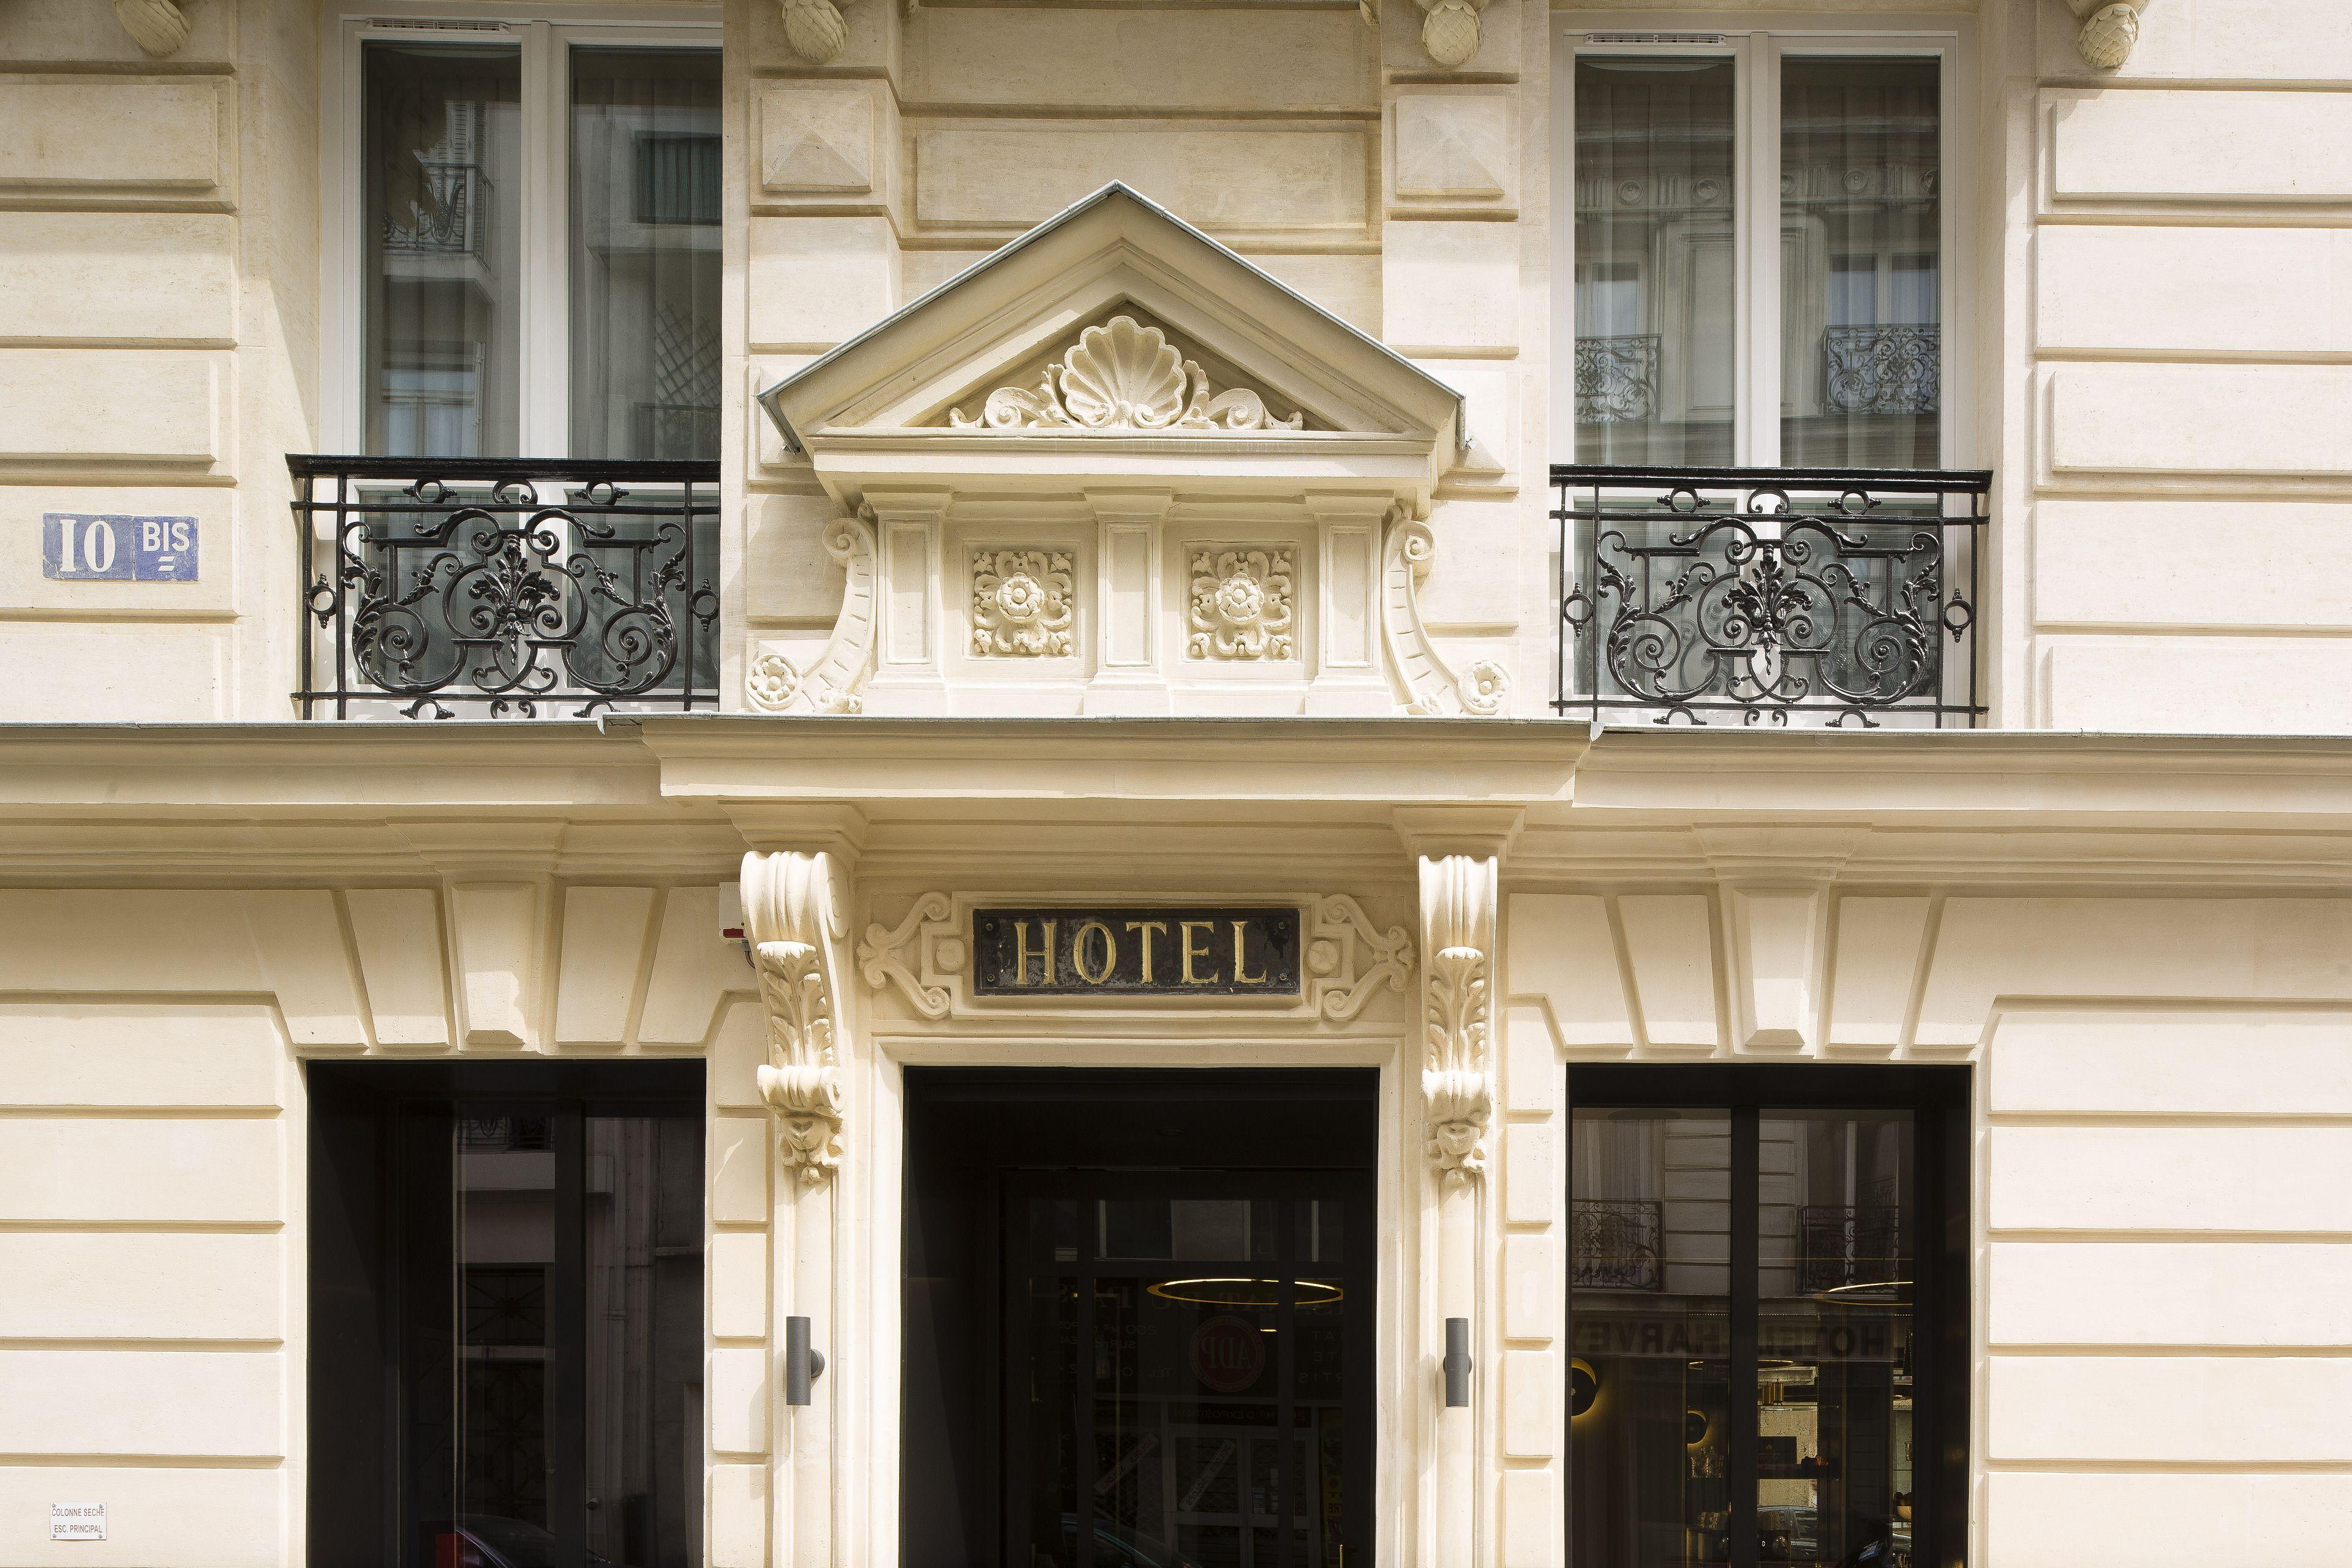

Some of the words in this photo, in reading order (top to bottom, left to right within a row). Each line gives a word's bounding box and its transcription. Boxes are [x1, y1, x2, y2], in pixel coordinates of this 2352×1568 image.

[59, 519, 116, 573] 10
[143, 522, 190, 552] BIS
[1014, 920, 1267, 985] HOTEL
[51, 1508, 81, 1517] COLONNE
[84, 1508, 104, 1517] SECHE
[54, 1525, 68, 1533] ESC.
[70, 1525, 102, 1533] PRINCIPAL
